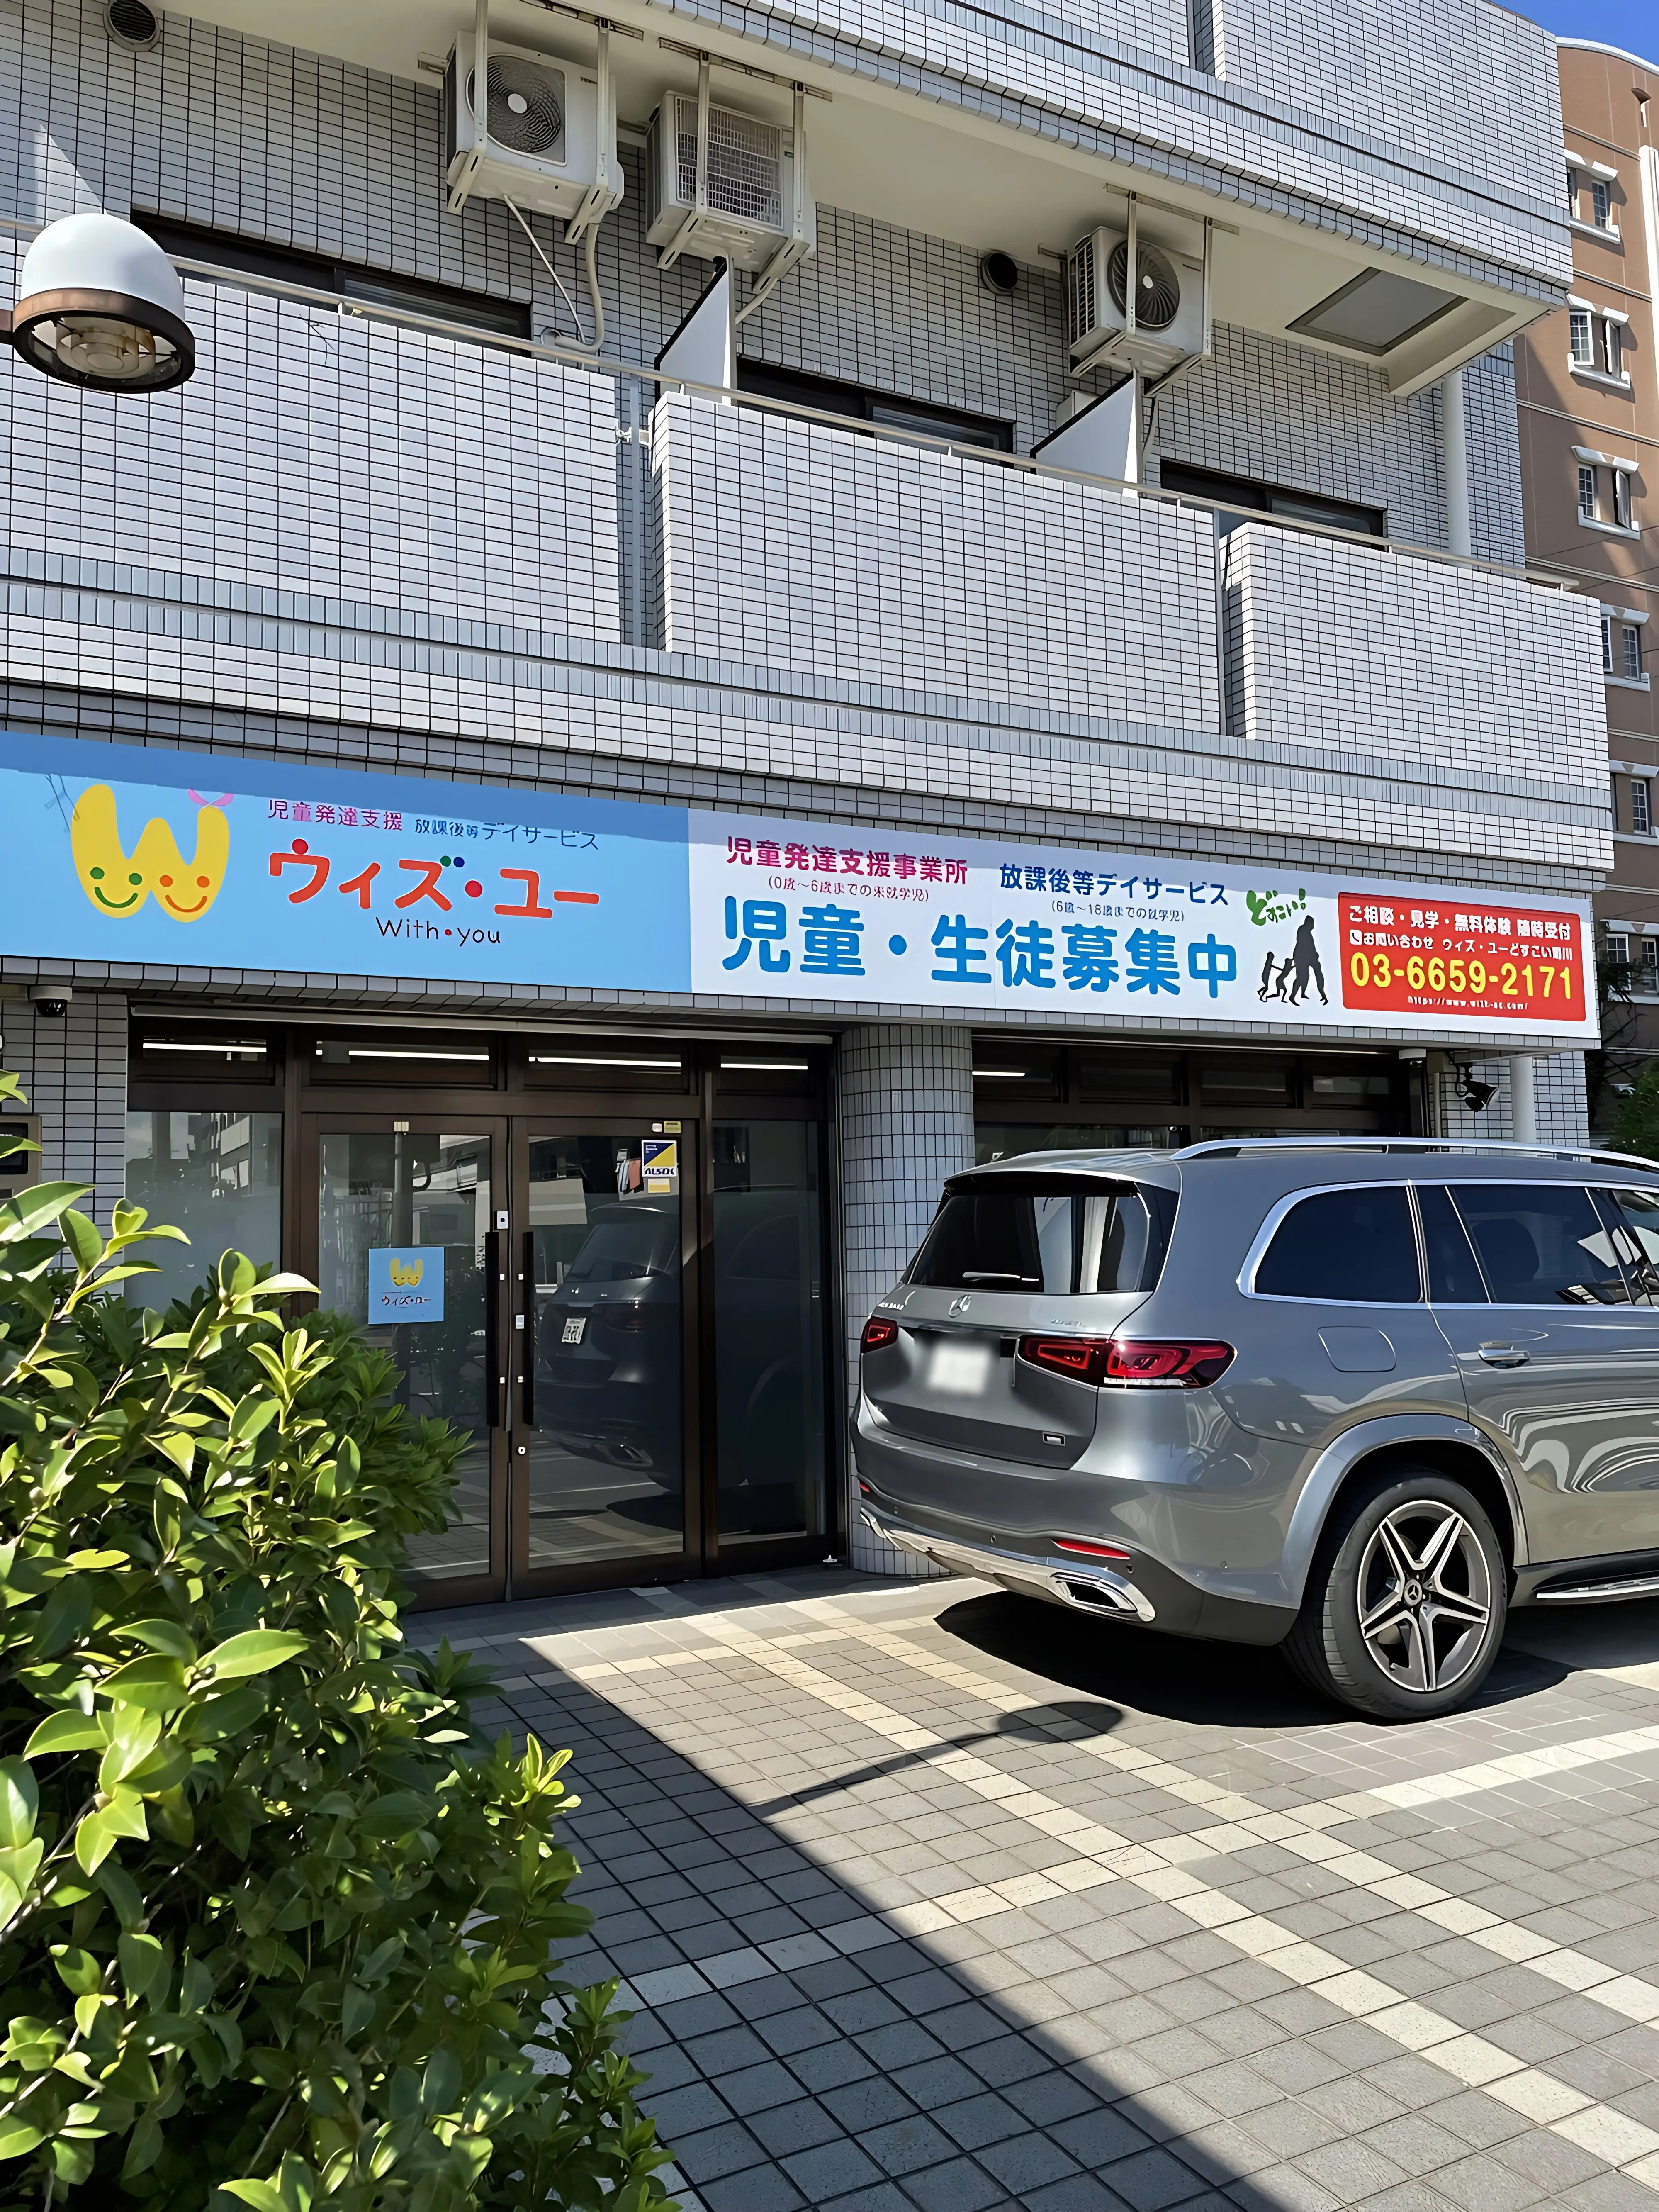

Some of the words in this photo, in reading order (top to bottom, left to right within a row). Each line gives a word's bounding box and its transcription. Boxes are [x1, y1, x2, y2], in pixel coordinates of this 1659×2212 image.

[268, 799, 402, 831] 児童発達支援
[269, 838, 599, 918] ウィズ・ユー
[727, 836, 968, 885] 児童発達支援事業所
[1000, 863, 1229, 906] 放課後等デイサービス
[722, 896, 1238, 999] 児童・生徒募集中
[1351, 952, 1571, 999] 03-6659-2171
